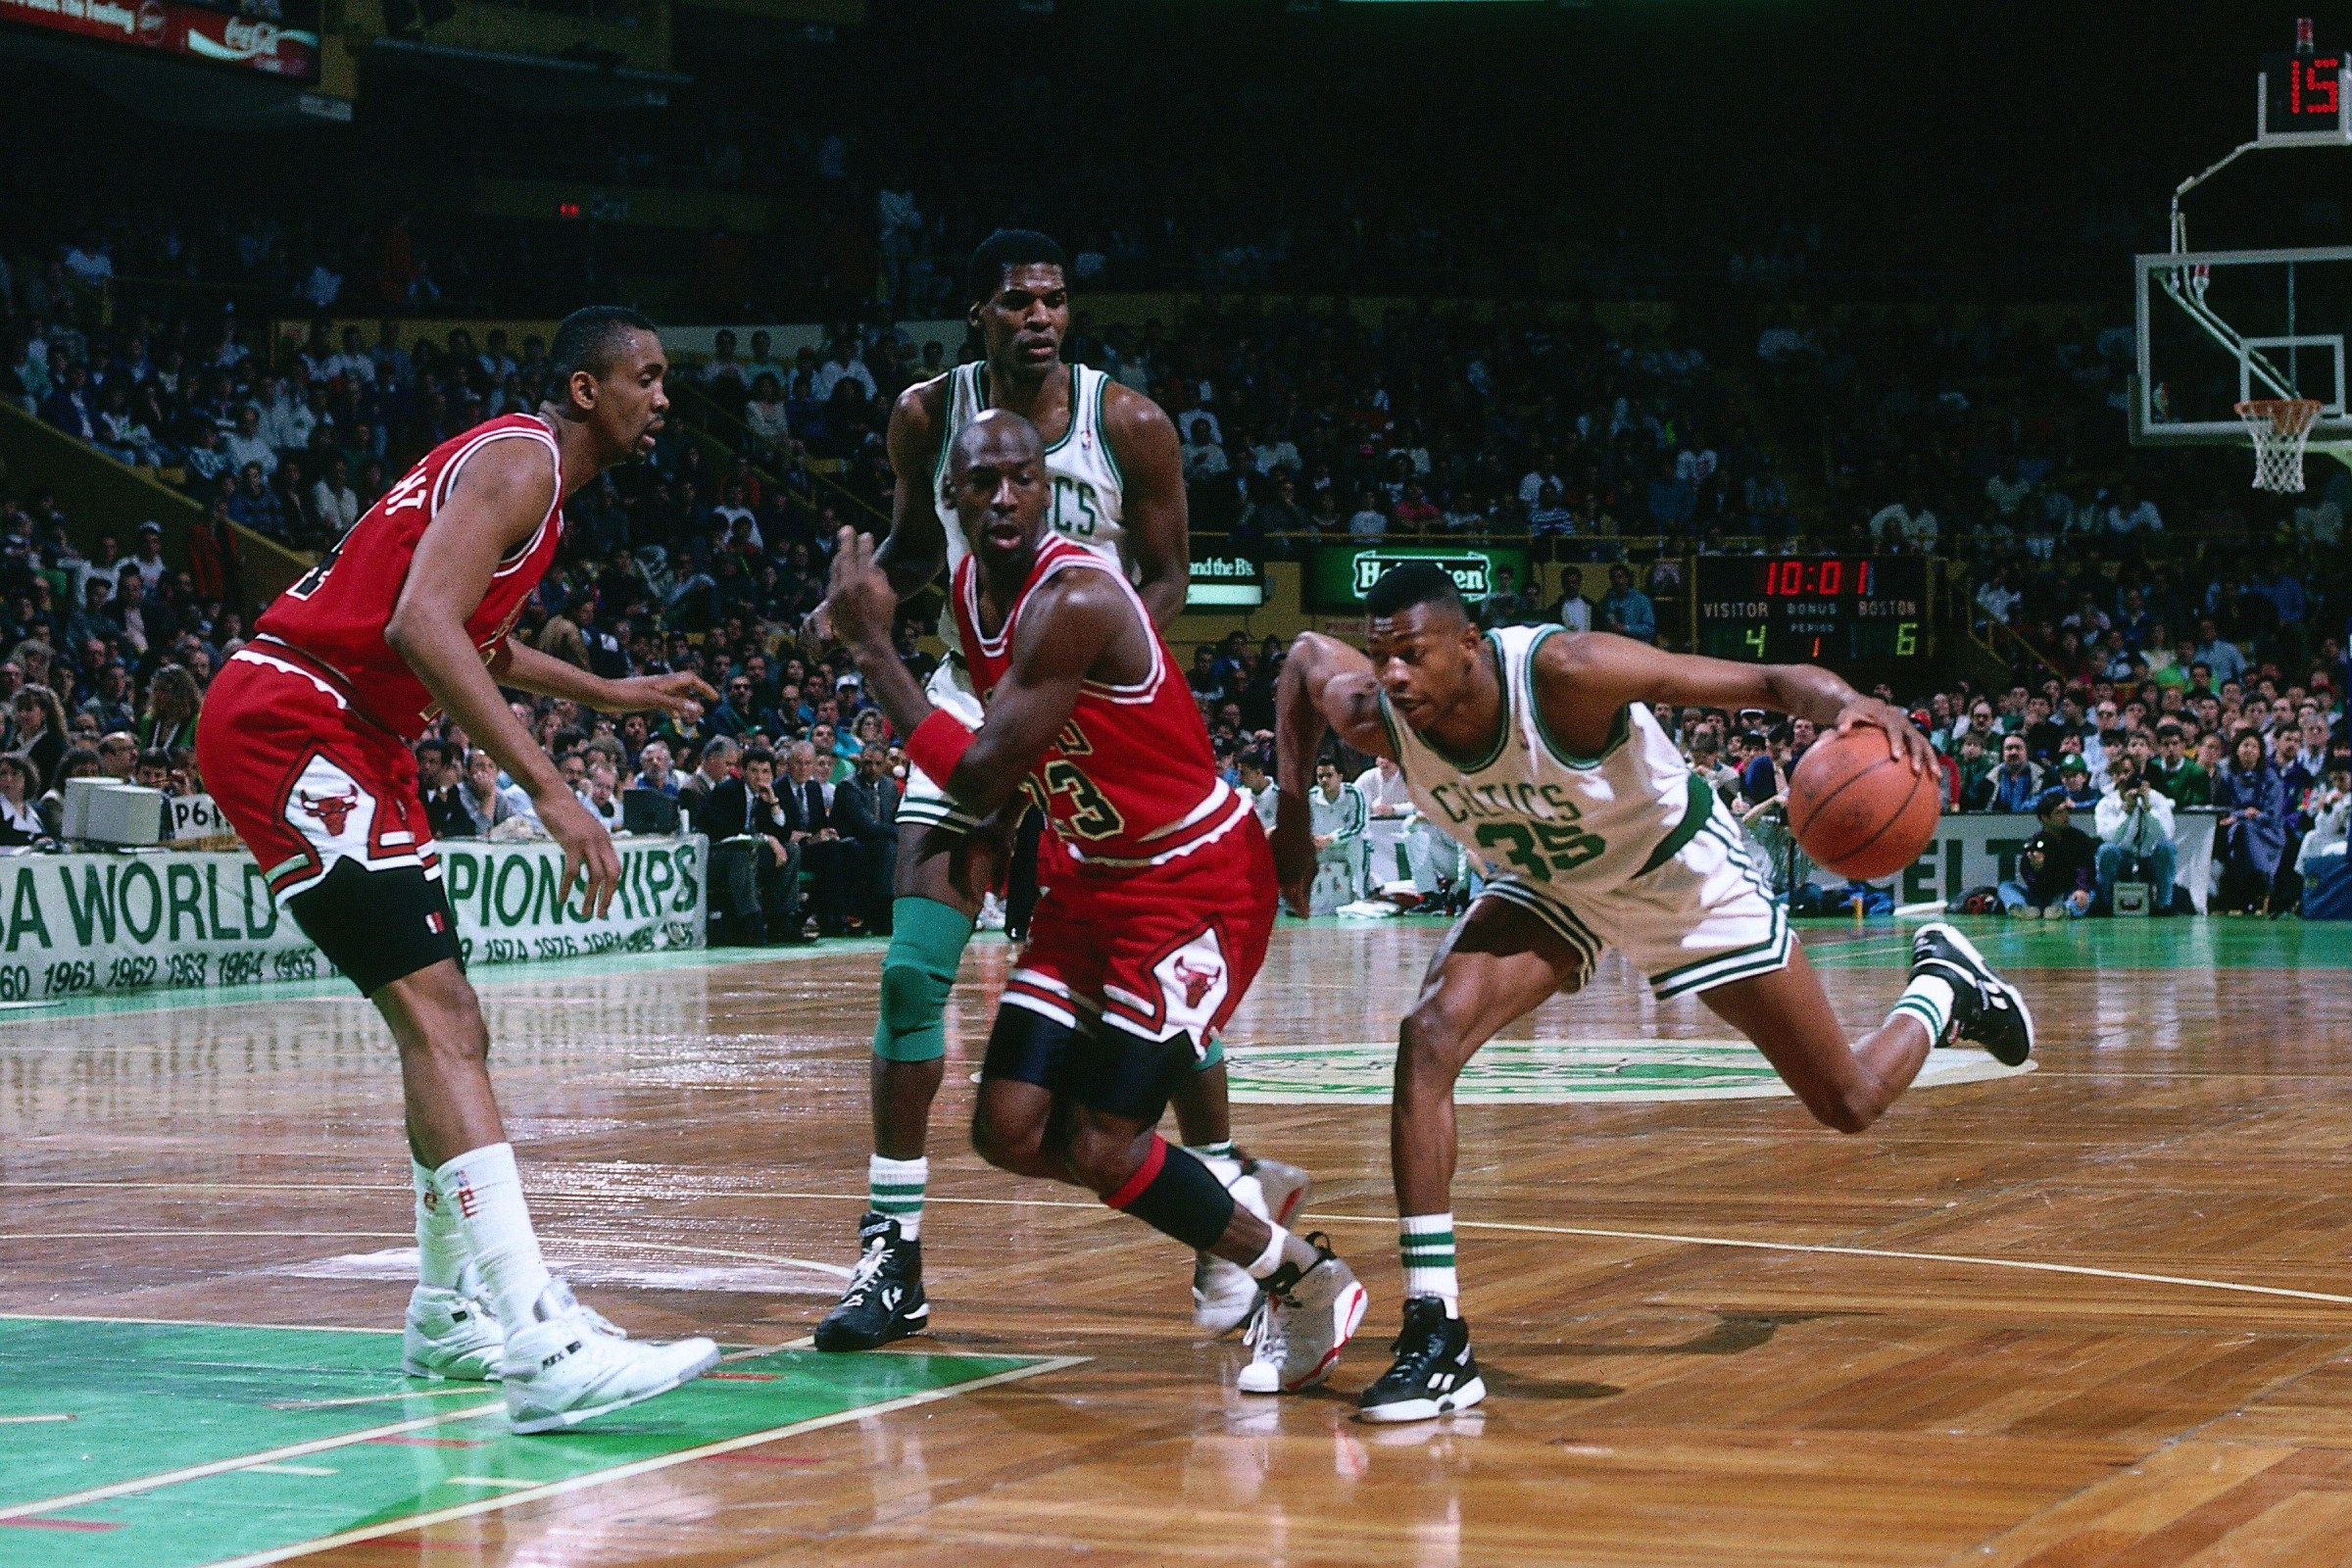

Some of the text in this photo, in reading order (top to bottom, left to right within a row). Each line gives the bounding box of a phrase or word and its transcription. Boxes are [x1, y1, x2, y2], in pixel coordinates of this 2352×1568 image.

[2291, 58, 2339, 115] 15
[1213, 557, 1234, 576] the
[1766, 560, 1869, 596] 10:01
[1703, 601, 1769, 618] VISITOR
[1787, 602, 1838, 615] BONUS
[1858, 599, 1917, 616] BOSTON
[1745, 623, 1767, 660] 4
[1811, 636, 1820, 660] 1
[1895, 621, 1918, 656] 6
[1475, 819, 1606, 882] 35
[59, 861, 278, 948] WORLD
[44, 960, 96, 994] 1961
[106, 956, 158, 988] 1962
[219, 950, 268, 986] 1964
[486, 938, 528, 963] 1974
[534, 935, 578, 960] 1976
